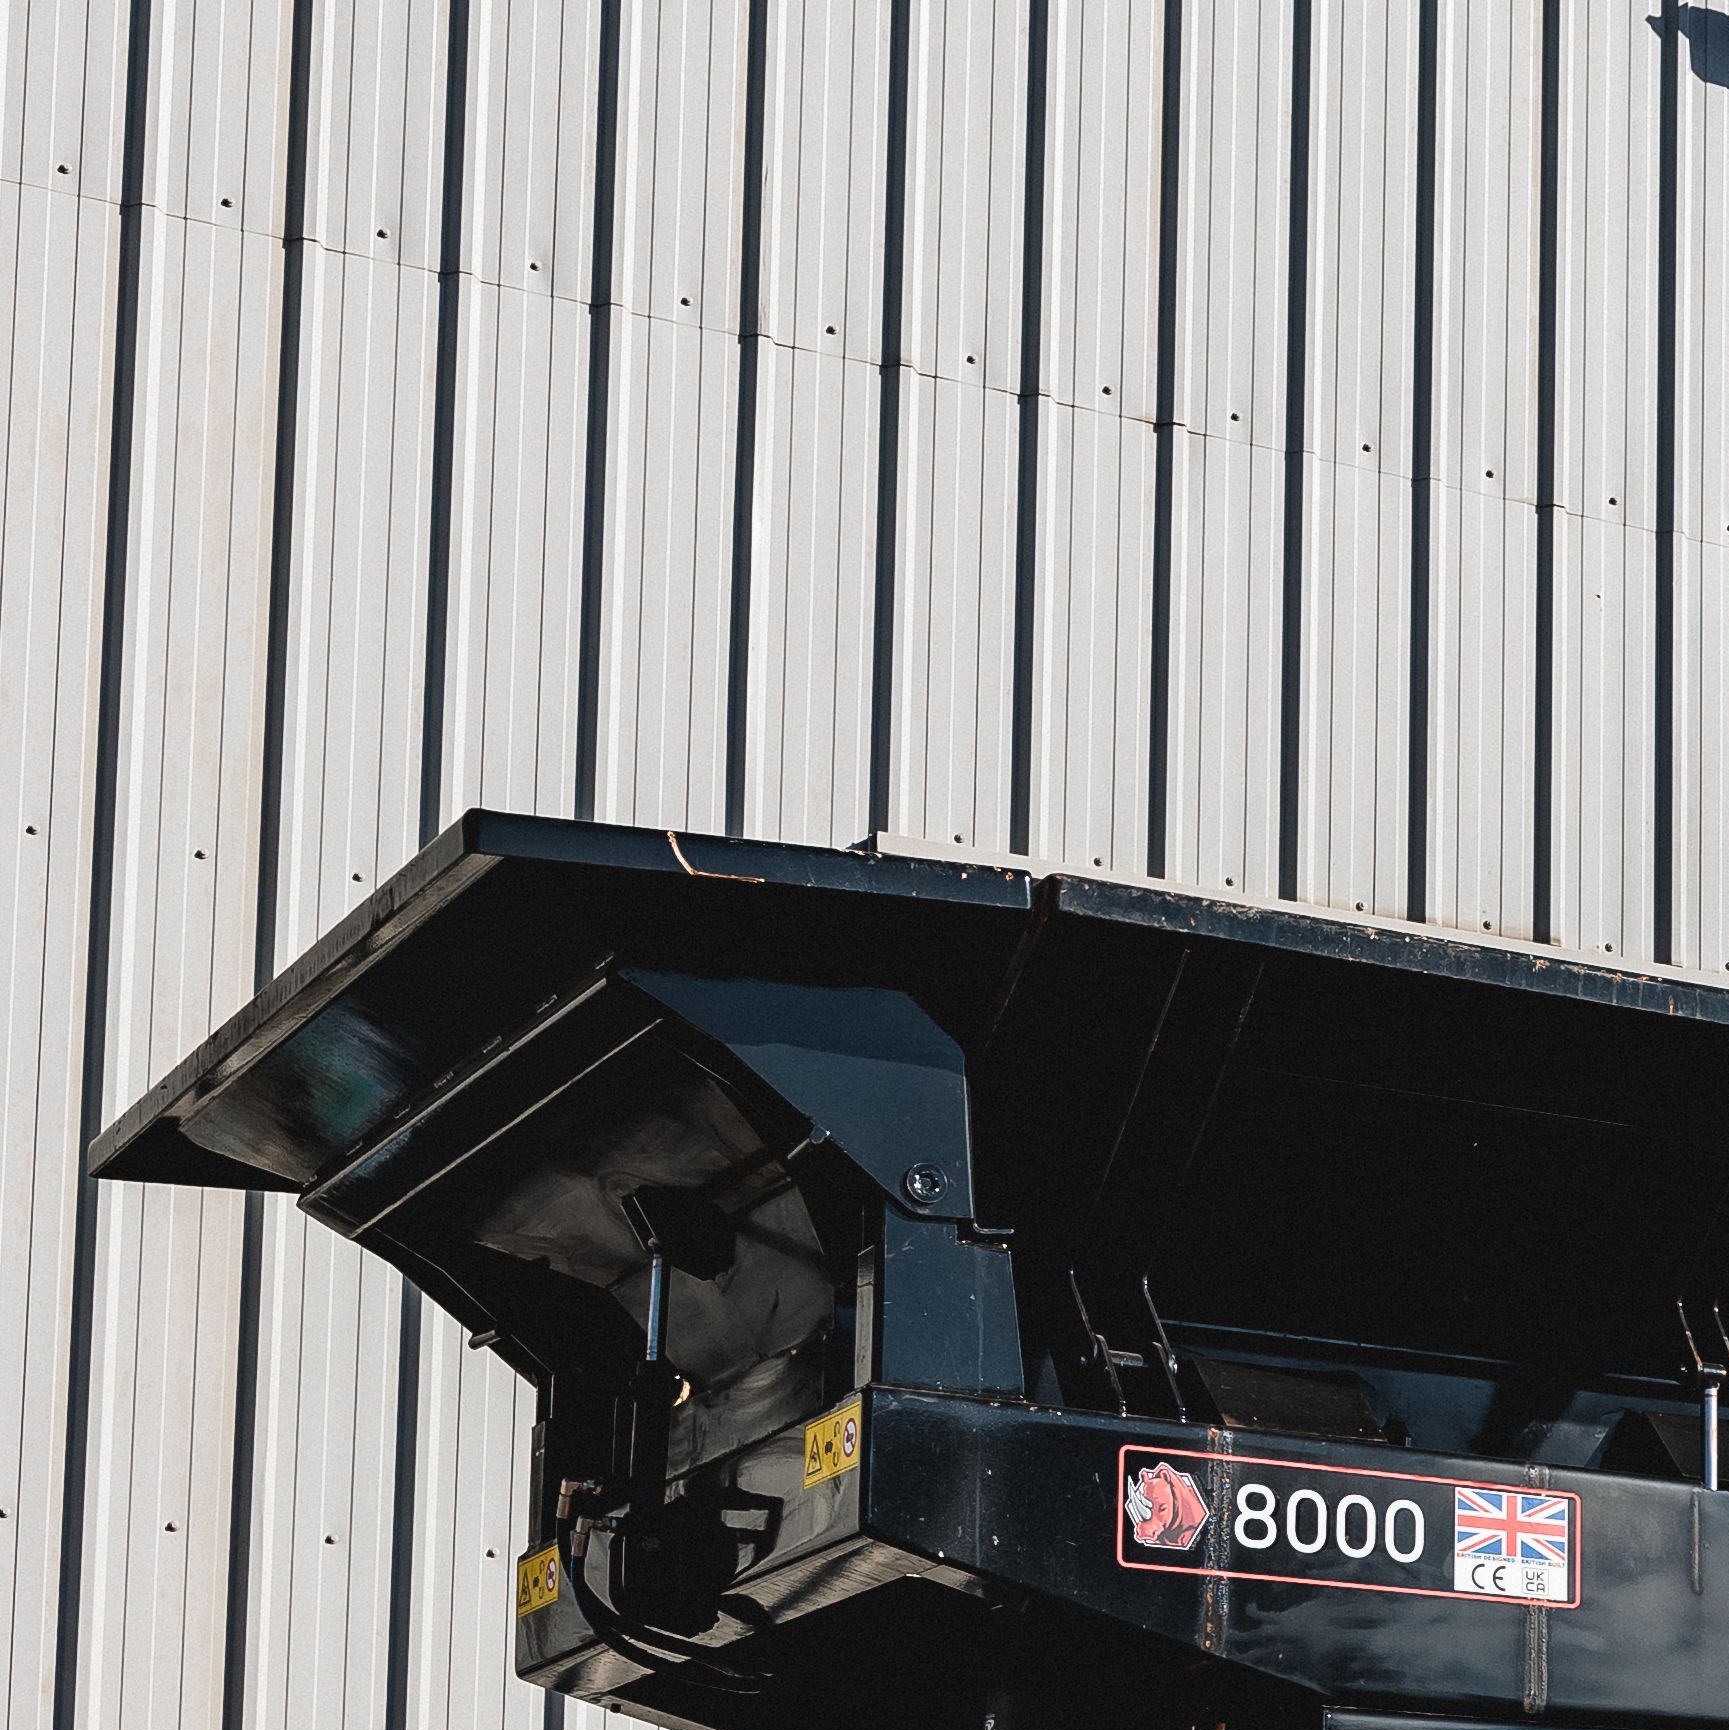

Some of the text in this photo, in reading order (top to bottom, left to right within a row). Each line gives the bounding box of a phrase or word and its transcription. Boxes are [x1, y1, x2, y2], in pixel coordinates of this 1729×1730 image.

[1235, 1483, 1425, 1564] 8000
[1484, 1555, 1515, 1563] DESIGNED
[1521, 1558, 1546, 1566] BRITISH
[1472, 1563, 1506, 1592] CE
[1525, 1571, 1545, 1582] UK
[1525, 1581, 1546, 1593] CA
